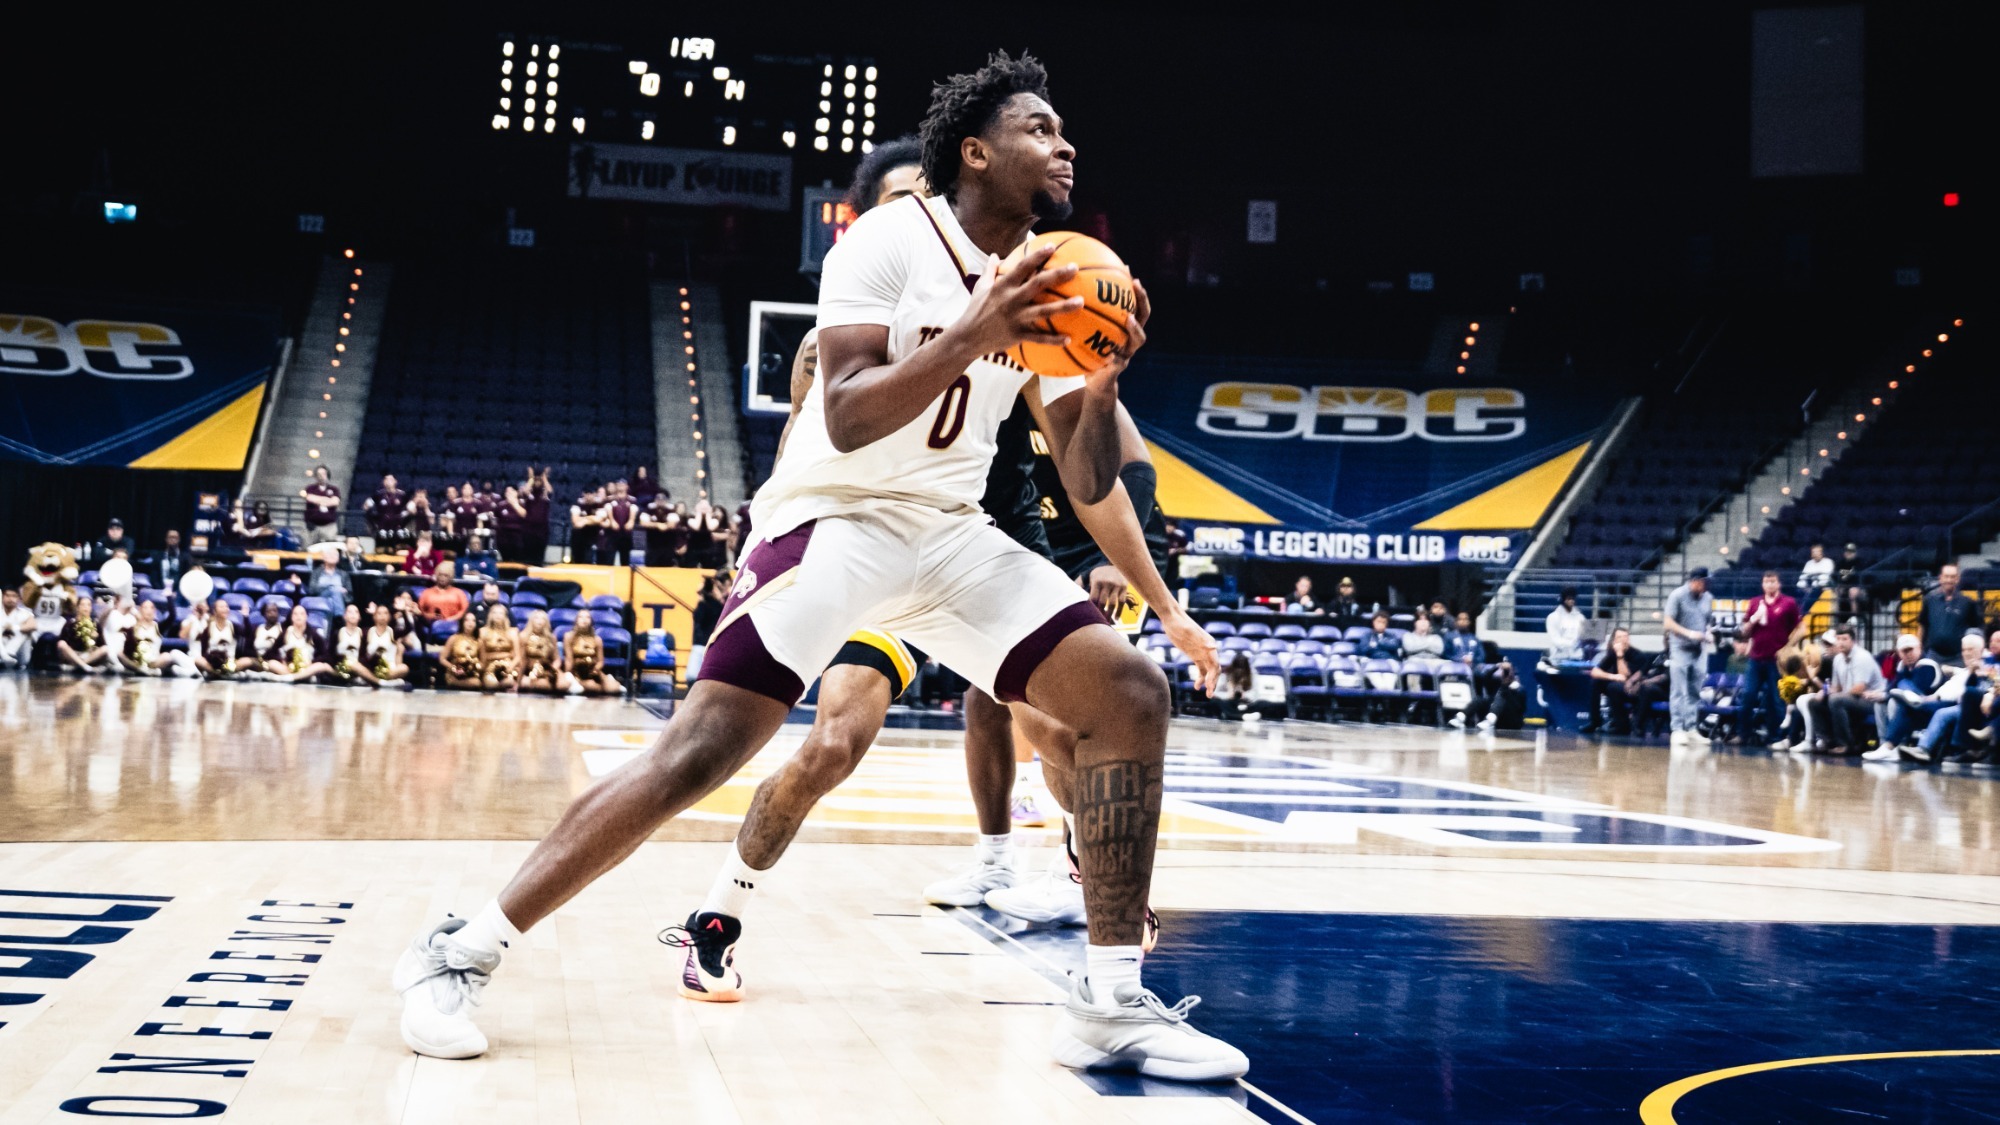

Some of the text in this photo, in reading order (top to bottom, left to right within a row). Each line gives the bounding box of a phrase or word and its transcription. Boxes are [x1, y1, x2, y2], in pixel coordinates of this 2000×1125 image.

[1095, 279, 1137, 314] Wil
[0, 313, 195, 381] BC
[1083, 329, 1122, 358] NC
[927, 373, 972, 451] 0
[1196, 381, 1527, 442] SBC
[1254, 530, 1371, 560] LEGENDS
[1377, 533, 1446, 562] CLUB
[1077, 763, 1140, 804] AITH
[58, 898, 355, 1119] ONFERENCE
